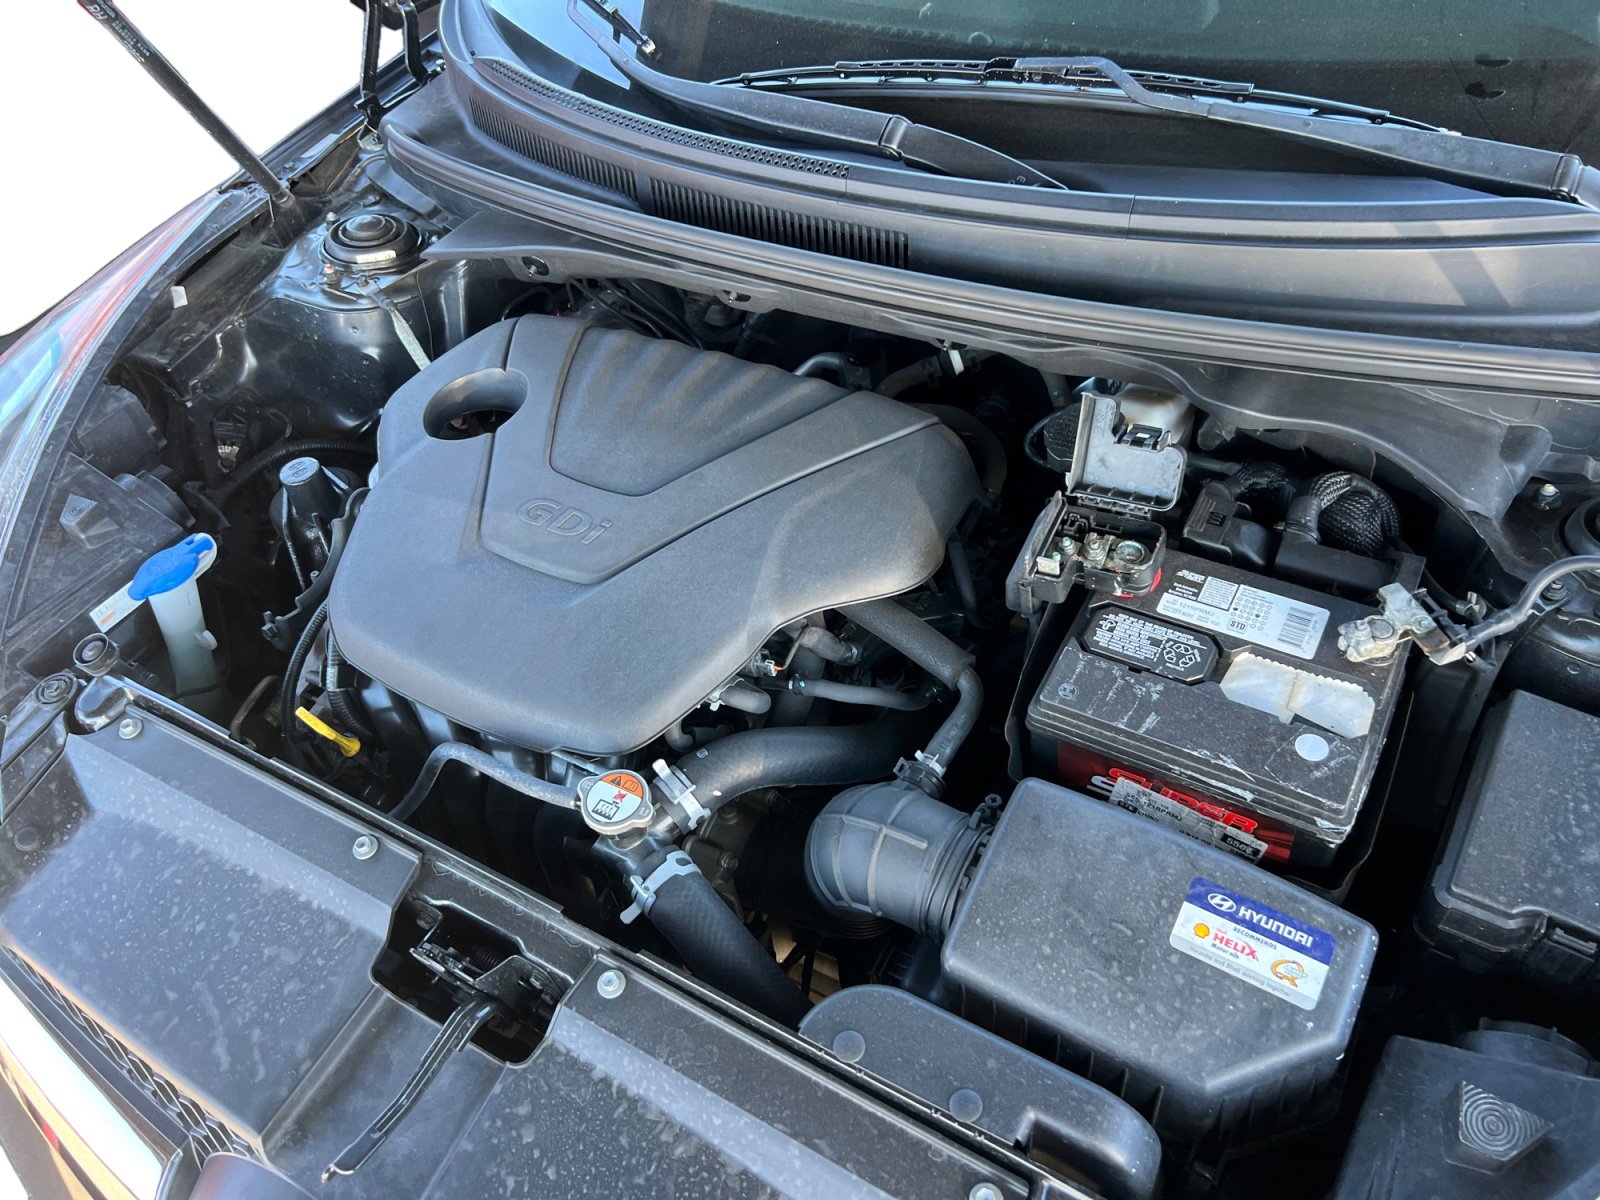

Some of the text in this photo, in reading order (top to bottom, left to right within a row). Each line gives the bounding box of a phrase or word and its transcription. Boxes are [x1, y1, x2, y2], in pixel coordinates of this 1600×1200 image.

[517, 498, 613, 545] GDi
[1230, 620, 1246, 631] STD
[1233, 926, 1277, 950] RECOMMENDS
[1238, 905, 1313, 948] HYUNDAI
[1213, 933, 1258, 961] HELIX
